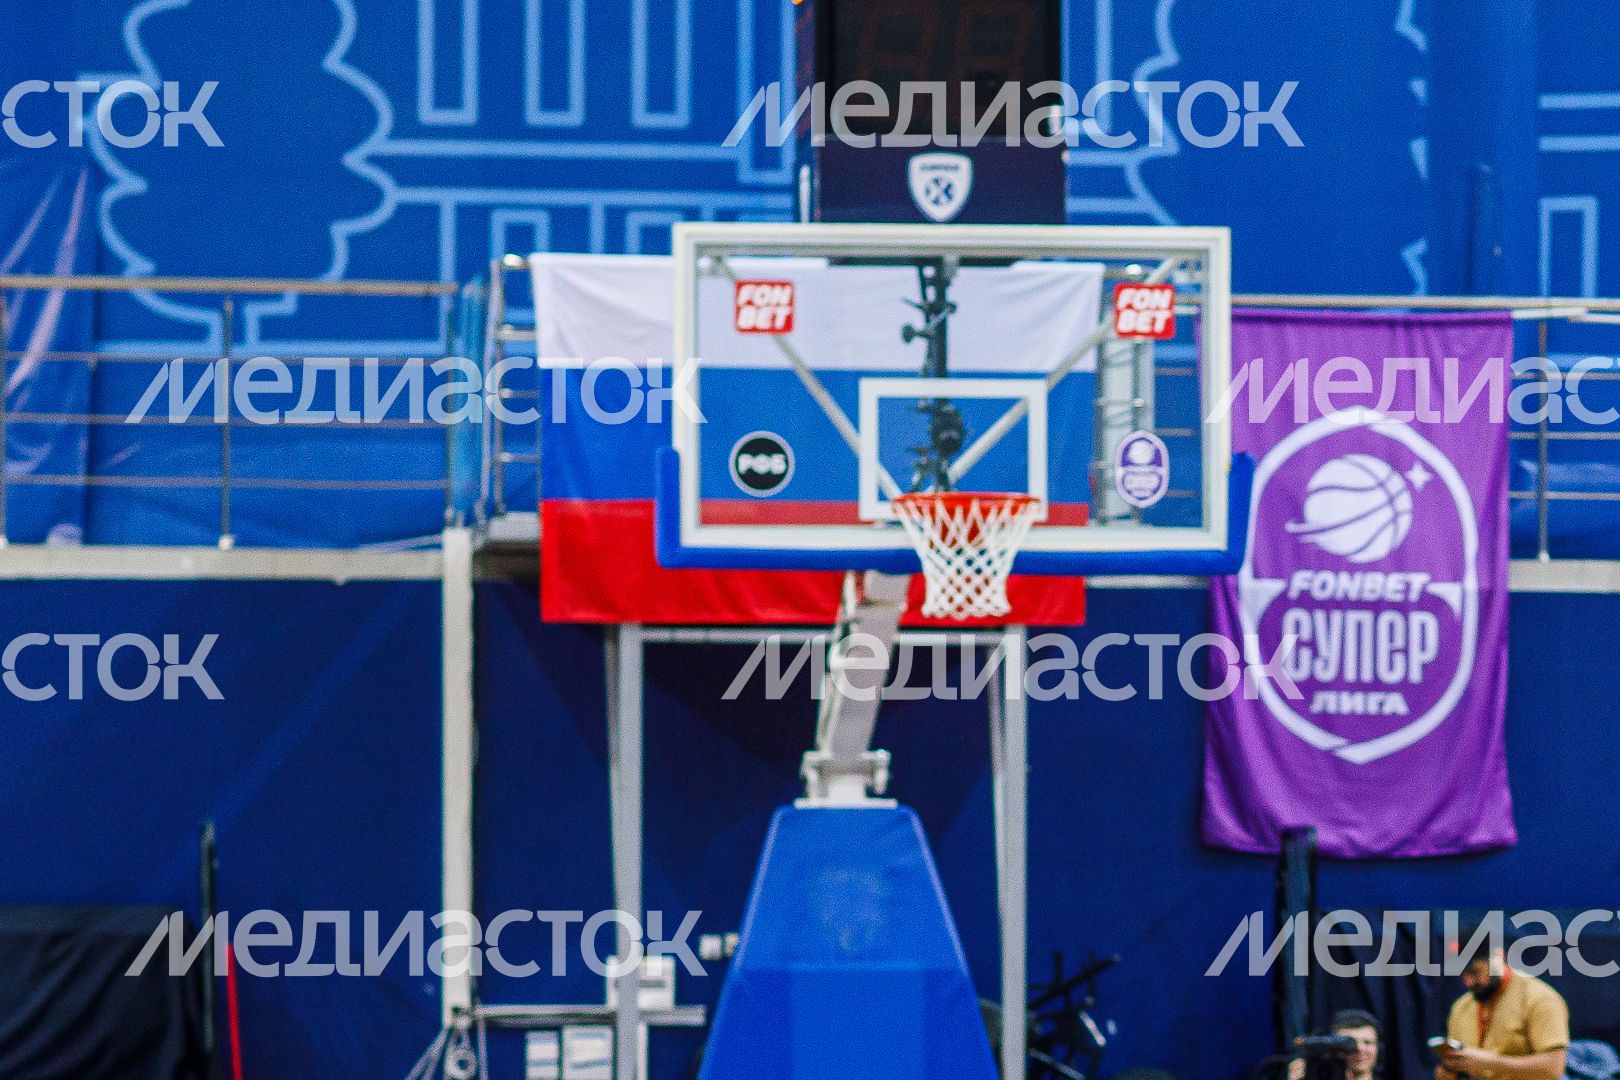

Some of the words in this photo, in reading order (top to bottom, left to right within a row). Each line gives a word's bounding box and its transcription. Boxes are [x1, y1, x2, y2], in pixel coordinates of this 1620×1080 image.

[738, 283, 792, 305] FON
[1117, 288, 1172, 309] FON
[738, 305, 791, 330] BET
[1117, 309, 1171, 333] BET
[1287, 569, 1431, 602] FONBET
[1310, 690, 1409, 716] ЛИГА
